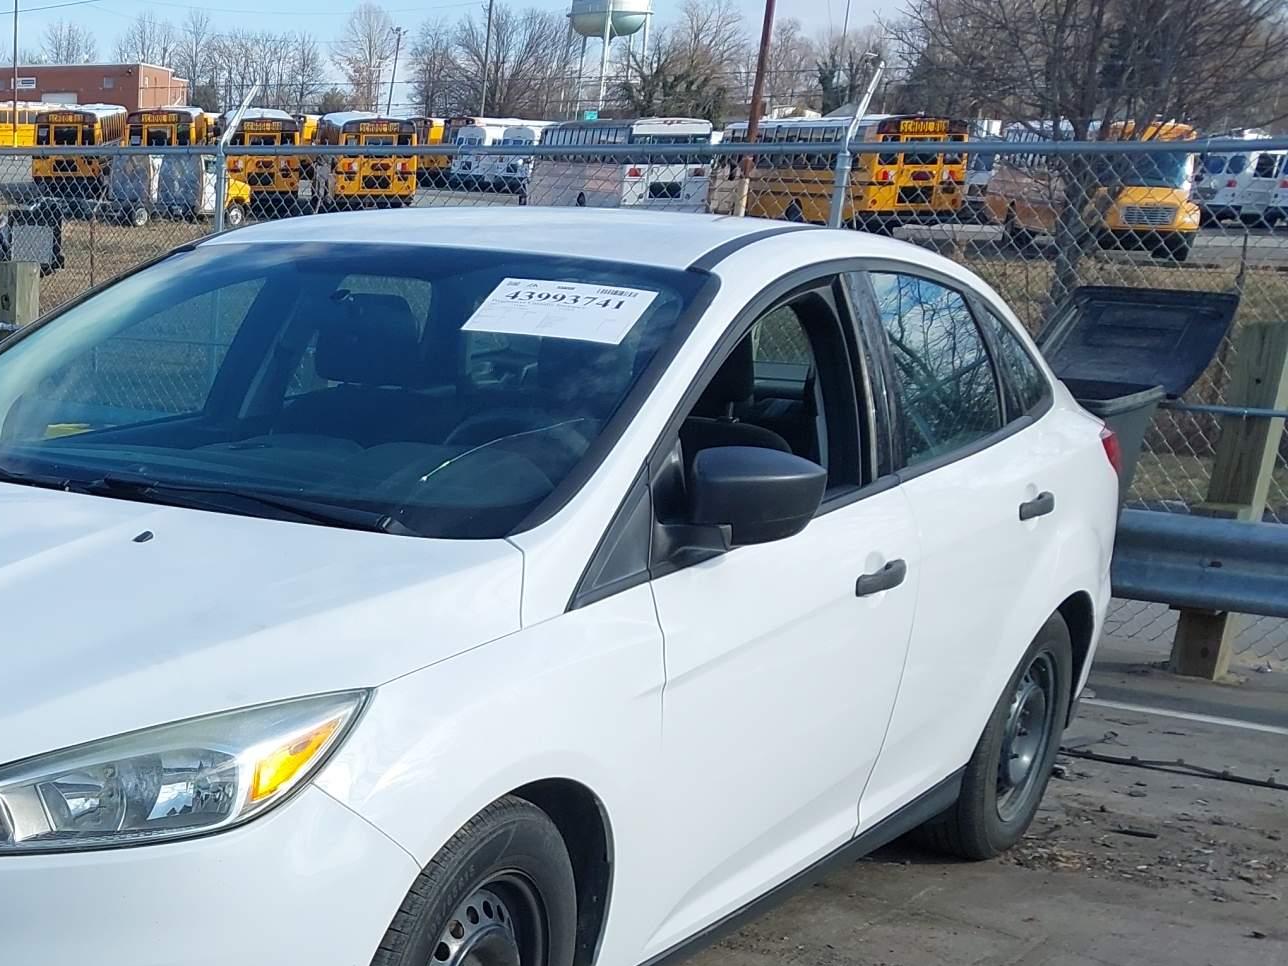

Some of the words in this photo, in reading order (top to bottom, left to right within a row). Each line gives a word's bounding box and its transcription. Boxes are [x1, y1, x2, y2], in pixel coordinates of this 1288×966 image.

[360, 122, 382, 132] SCHOOL
[902, 120, 929, 131] SCHOOL
[933, 120, 947, 131] BUS
[505, 290, 626, 309] 43993741
